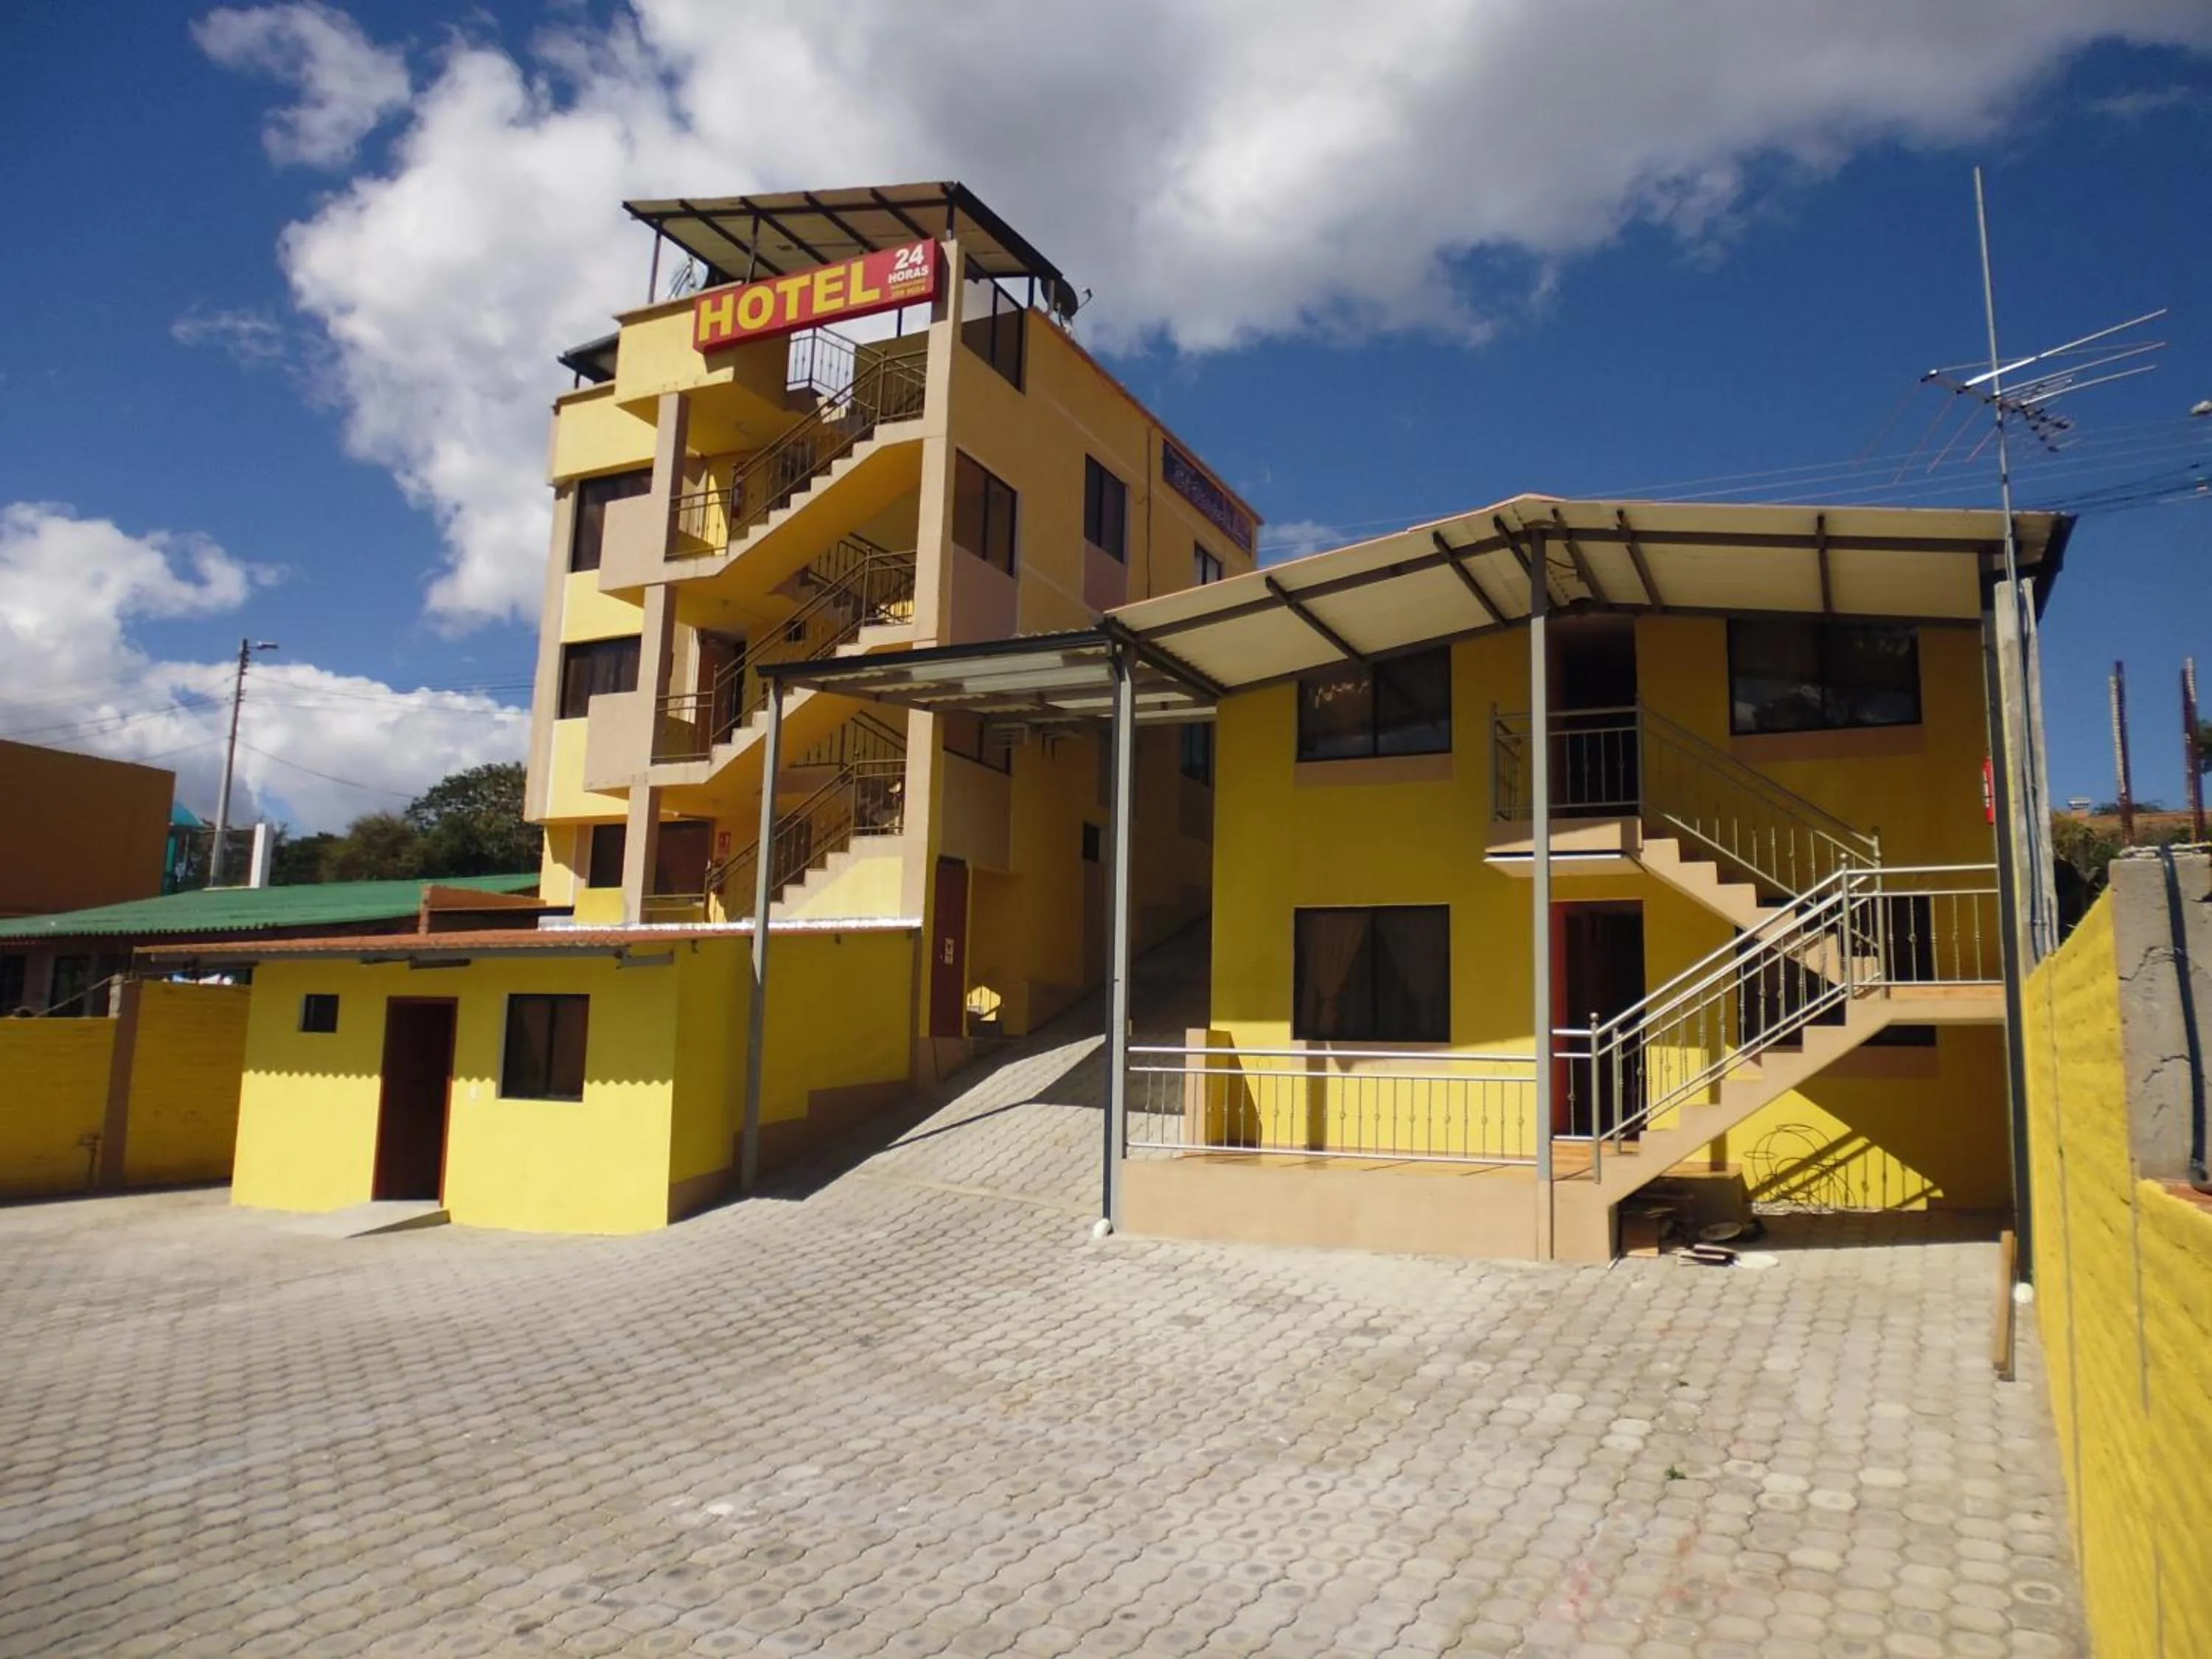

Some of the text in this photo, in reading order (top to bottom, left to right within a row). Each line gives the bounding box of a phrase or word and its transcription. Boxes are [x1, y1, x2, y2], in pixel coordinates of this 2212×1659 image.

[894, 244, 925, 270] 24
[888, 265, 929, 284] HORAS
[698, 260, 880, 342] HOTEL
